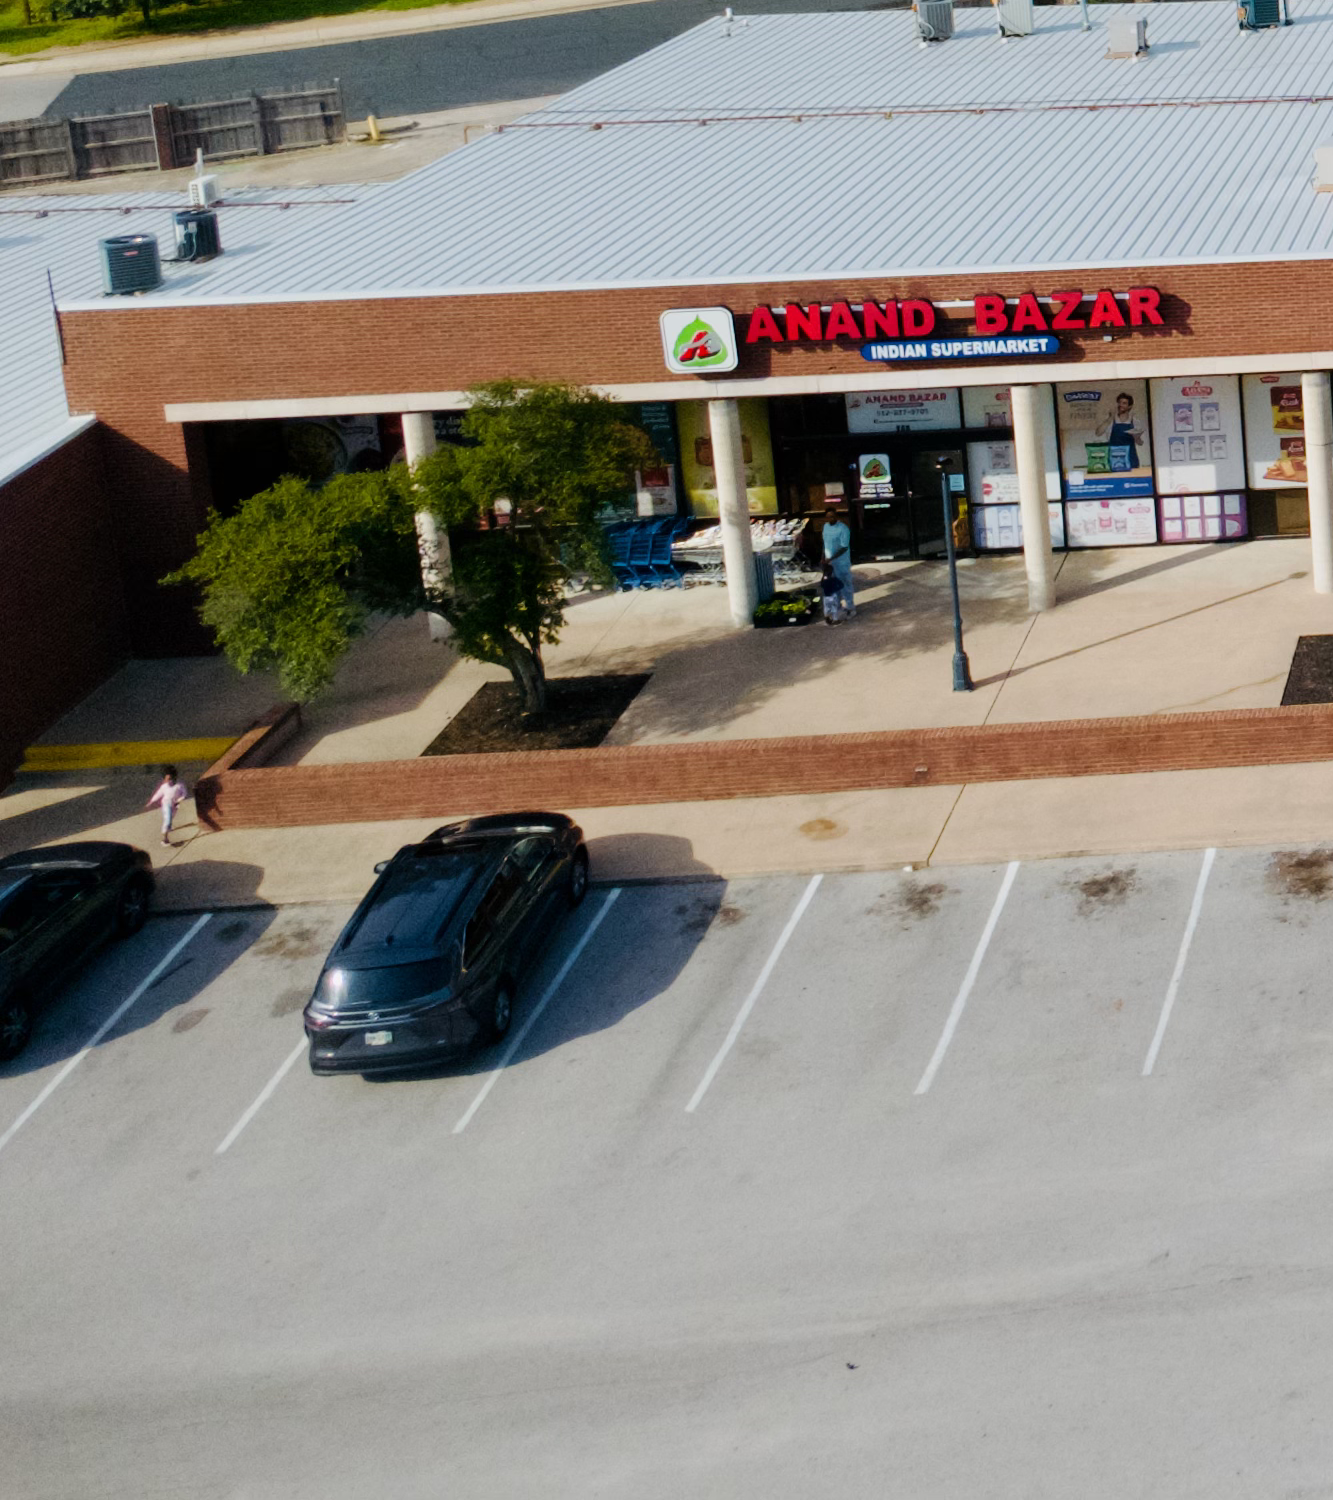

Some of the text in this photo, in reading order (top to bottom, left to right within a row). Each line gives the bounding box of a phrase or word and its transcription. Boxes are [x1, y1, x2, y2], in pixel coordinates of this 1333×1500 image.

[745, 287, 1165, 343] ANAND BAZAR
[870, 338, 1049, 360] INDIAN SUPERMARKET
[865, 392, 947, 404] ANAND BAZAR
